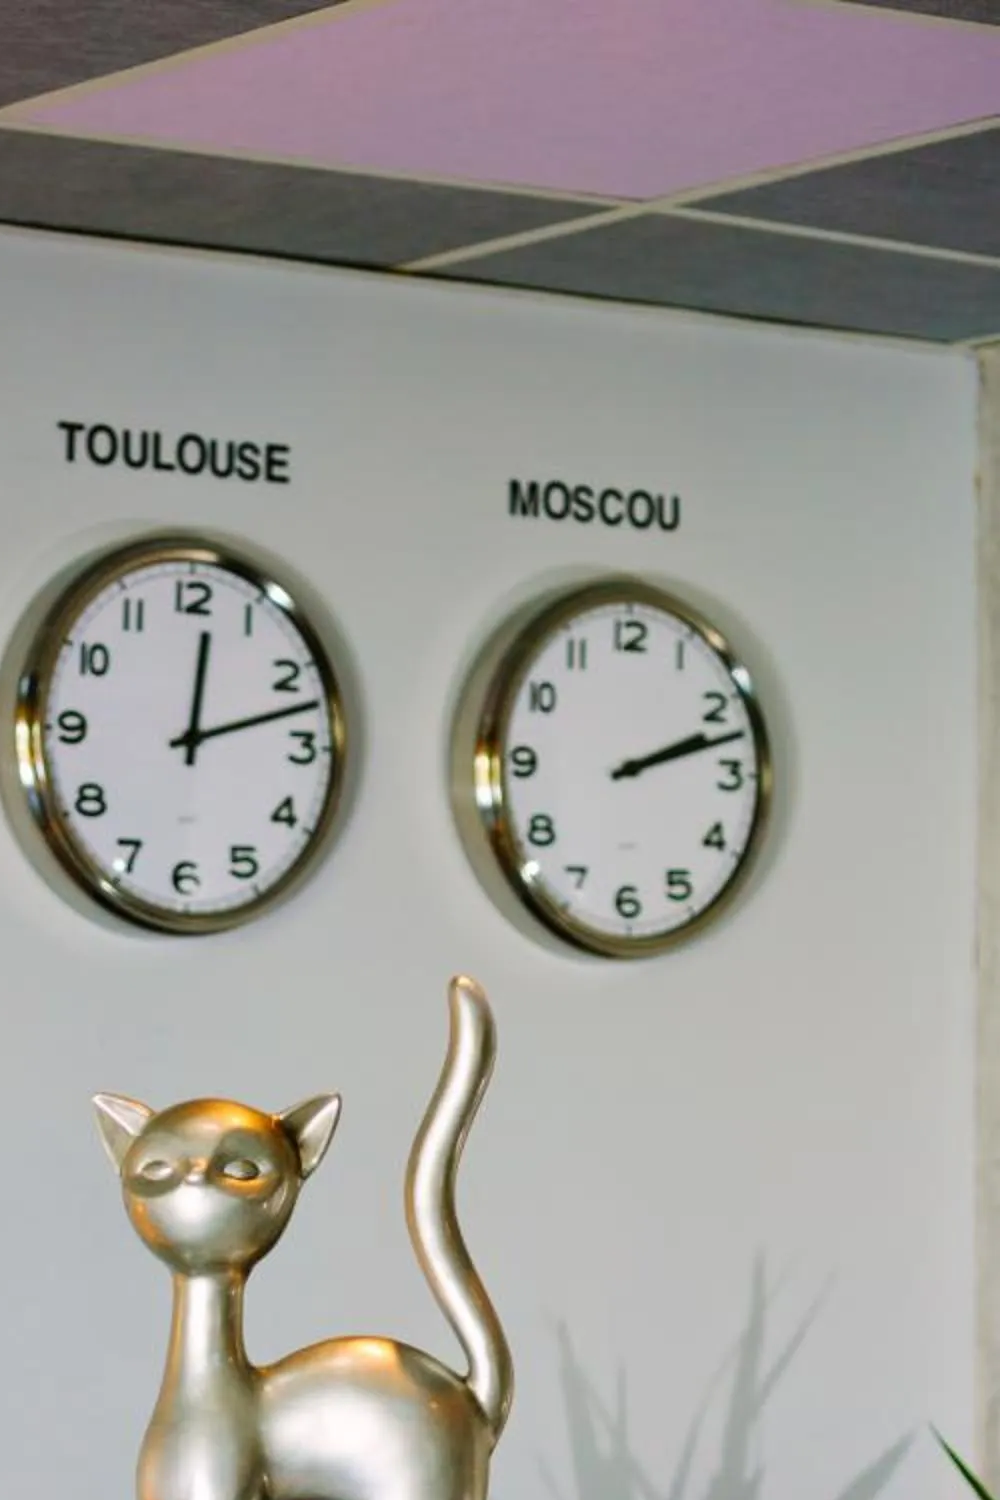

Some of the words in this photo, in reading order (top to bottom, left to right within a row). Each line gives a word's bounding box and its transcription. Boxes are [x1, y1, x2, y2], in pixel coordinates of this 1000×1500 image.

[56, 420, 291, 484] TOULOUSE
[508, 479, 681, 532] MOSCOU
[174, 580, 213, 616] 12
[121, 598, 145, 633] 11
[244, 603, 254, 637] 1
[613, 619, 648, 654] 12
[79, 642, 110, 677] 10
[566, 638, 588, 670] 11
[676, 640, 685, 671] 1
[272, 659, 301, 693] 2
[529, 681, 556, 714] 10
[702, 691, 729, 724] 2
[56, 709, 88, 745] 9
[287, 730, 317, 766] 3
[511, 746, 538, 779] 9
[717, 759, 744, 793] 3
[74, 782, 108, 818] 8
[270, 796, 299, 829] 4
[526, 813, 556, 848] 8
[702, 821, 728, 852] 4
[115, 838, 143, 875] 7
[229, 845, 260, 880] 5
[171, 861, 201, 894] 6
[564, 865, 589, 891] 7
[666, 869, 694, 902] 5
[614, 885, 642, 920] 6
